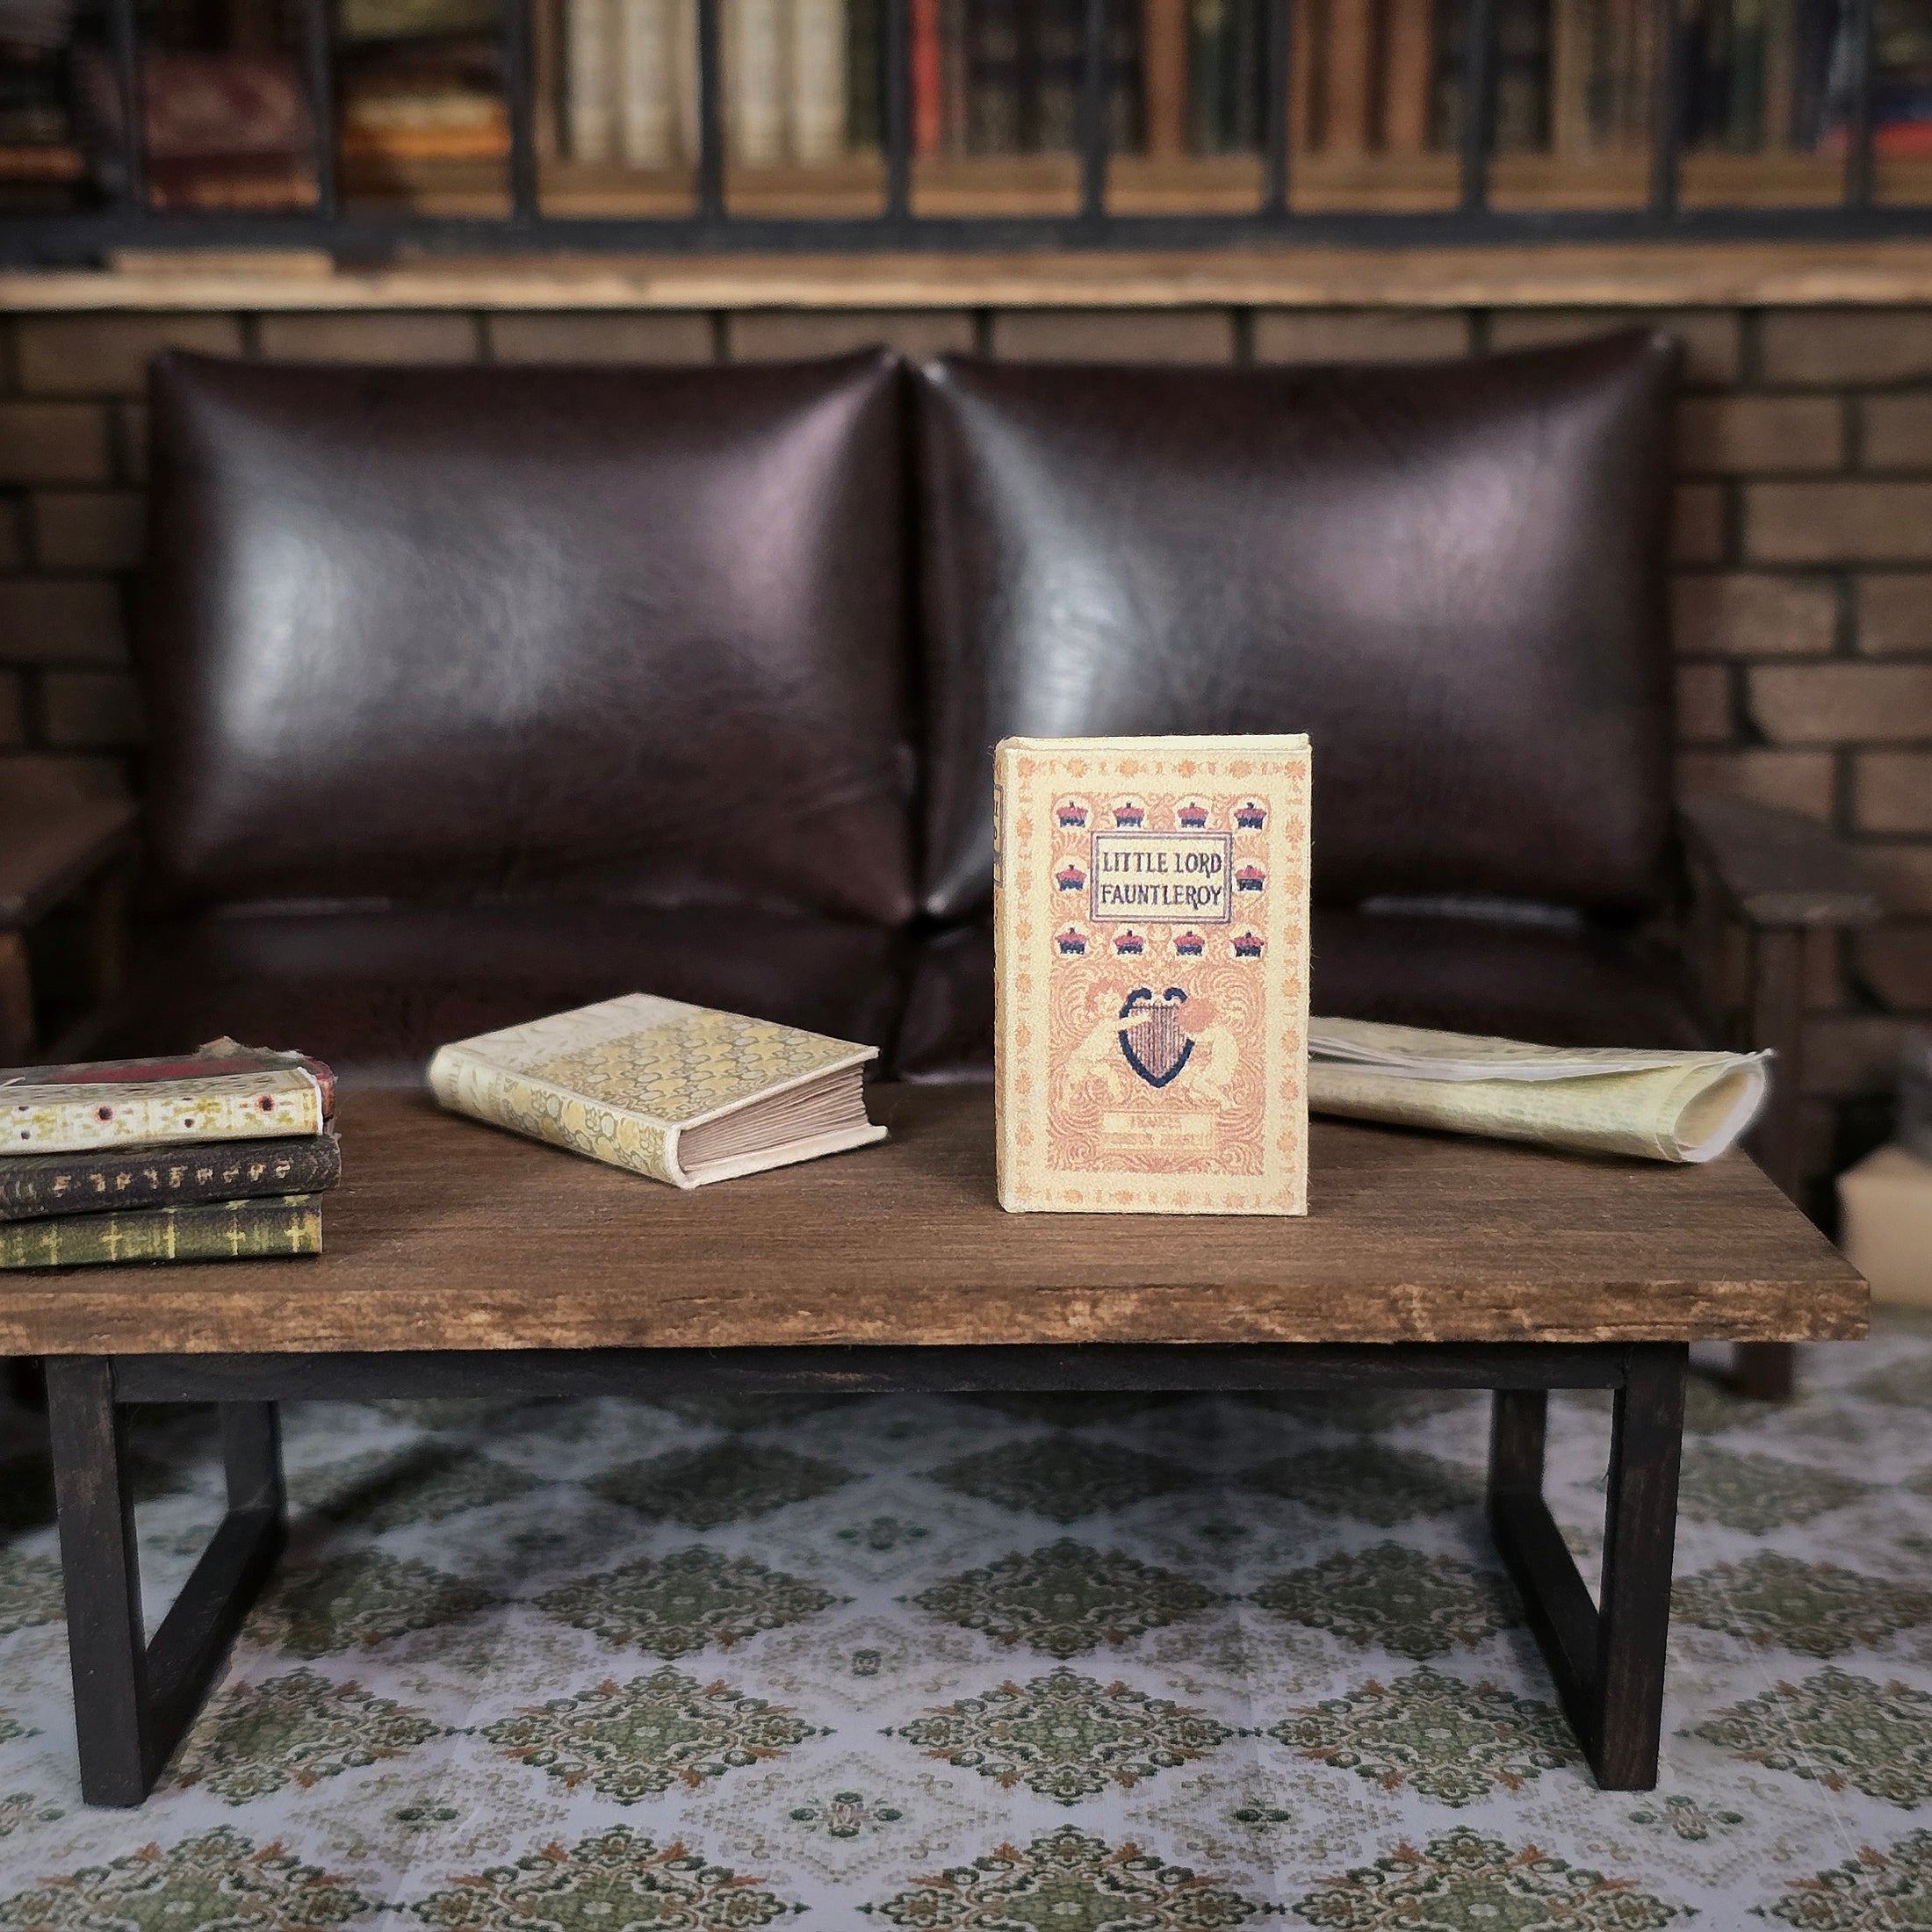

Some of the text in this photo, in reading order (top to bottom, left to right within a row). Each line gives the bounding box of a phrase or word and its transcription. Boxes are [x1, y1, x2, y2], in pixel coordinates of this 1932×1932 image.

[1102, 852, 1222, 878] LITTLE LORD
[1100, 884, 1222, 910] FAUNTLEROY
